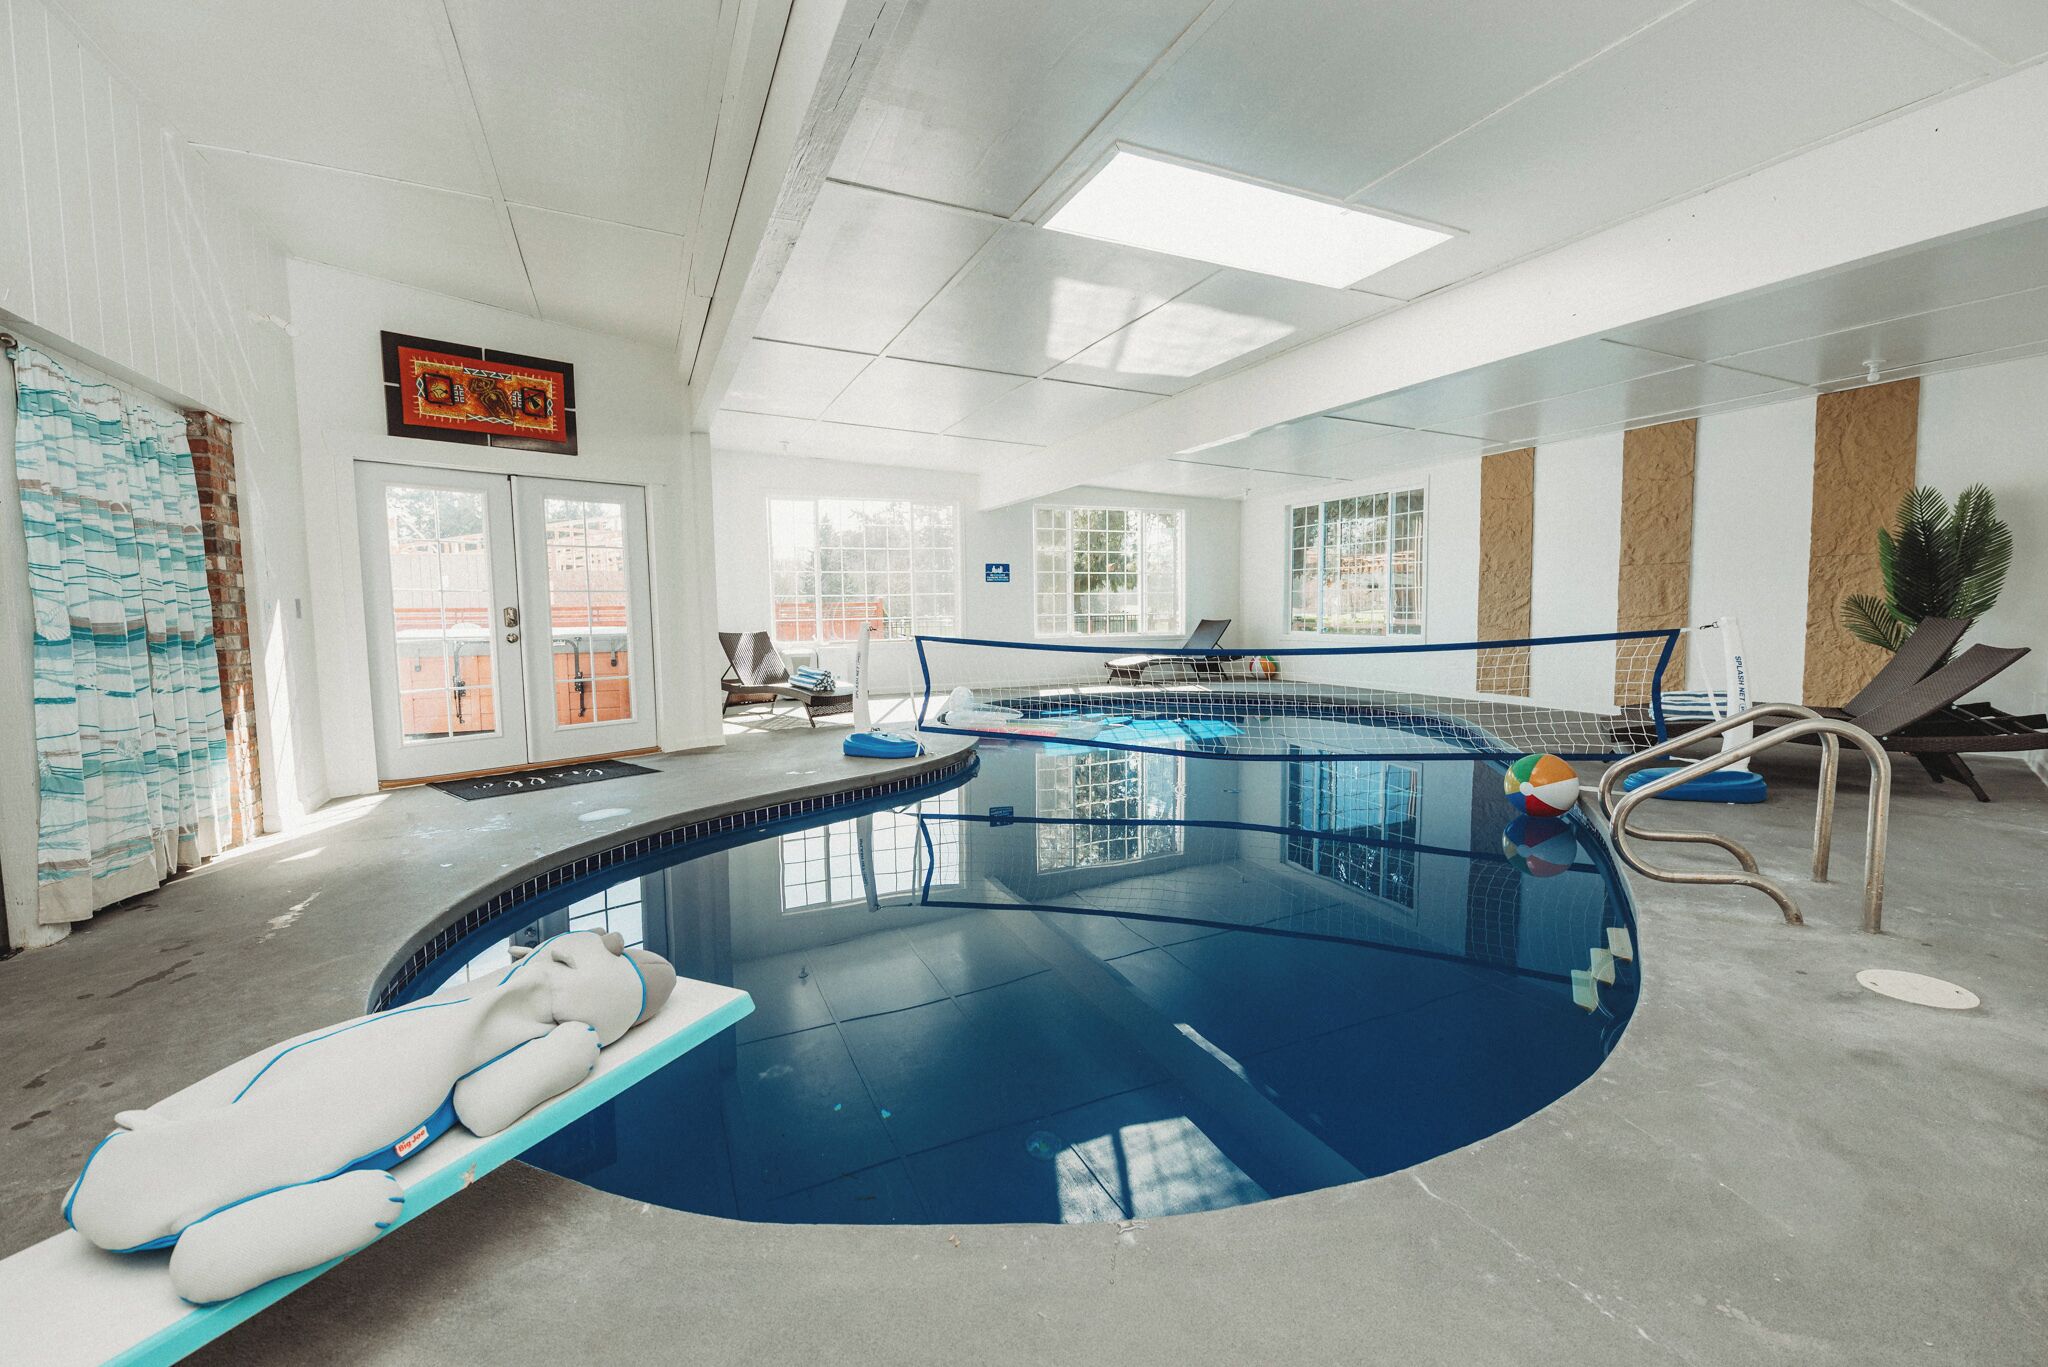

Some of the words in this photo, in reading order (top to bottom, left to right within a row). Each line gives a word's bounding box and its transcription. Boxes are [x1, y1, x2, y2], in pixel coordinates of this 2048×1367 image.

[1734, 655, 1745, 686] SPLASH
[1738, 687, 1746, 702] NET
[398, 1140, 412, 1153] Big
[412, 1129, 425, 1143] Joe
